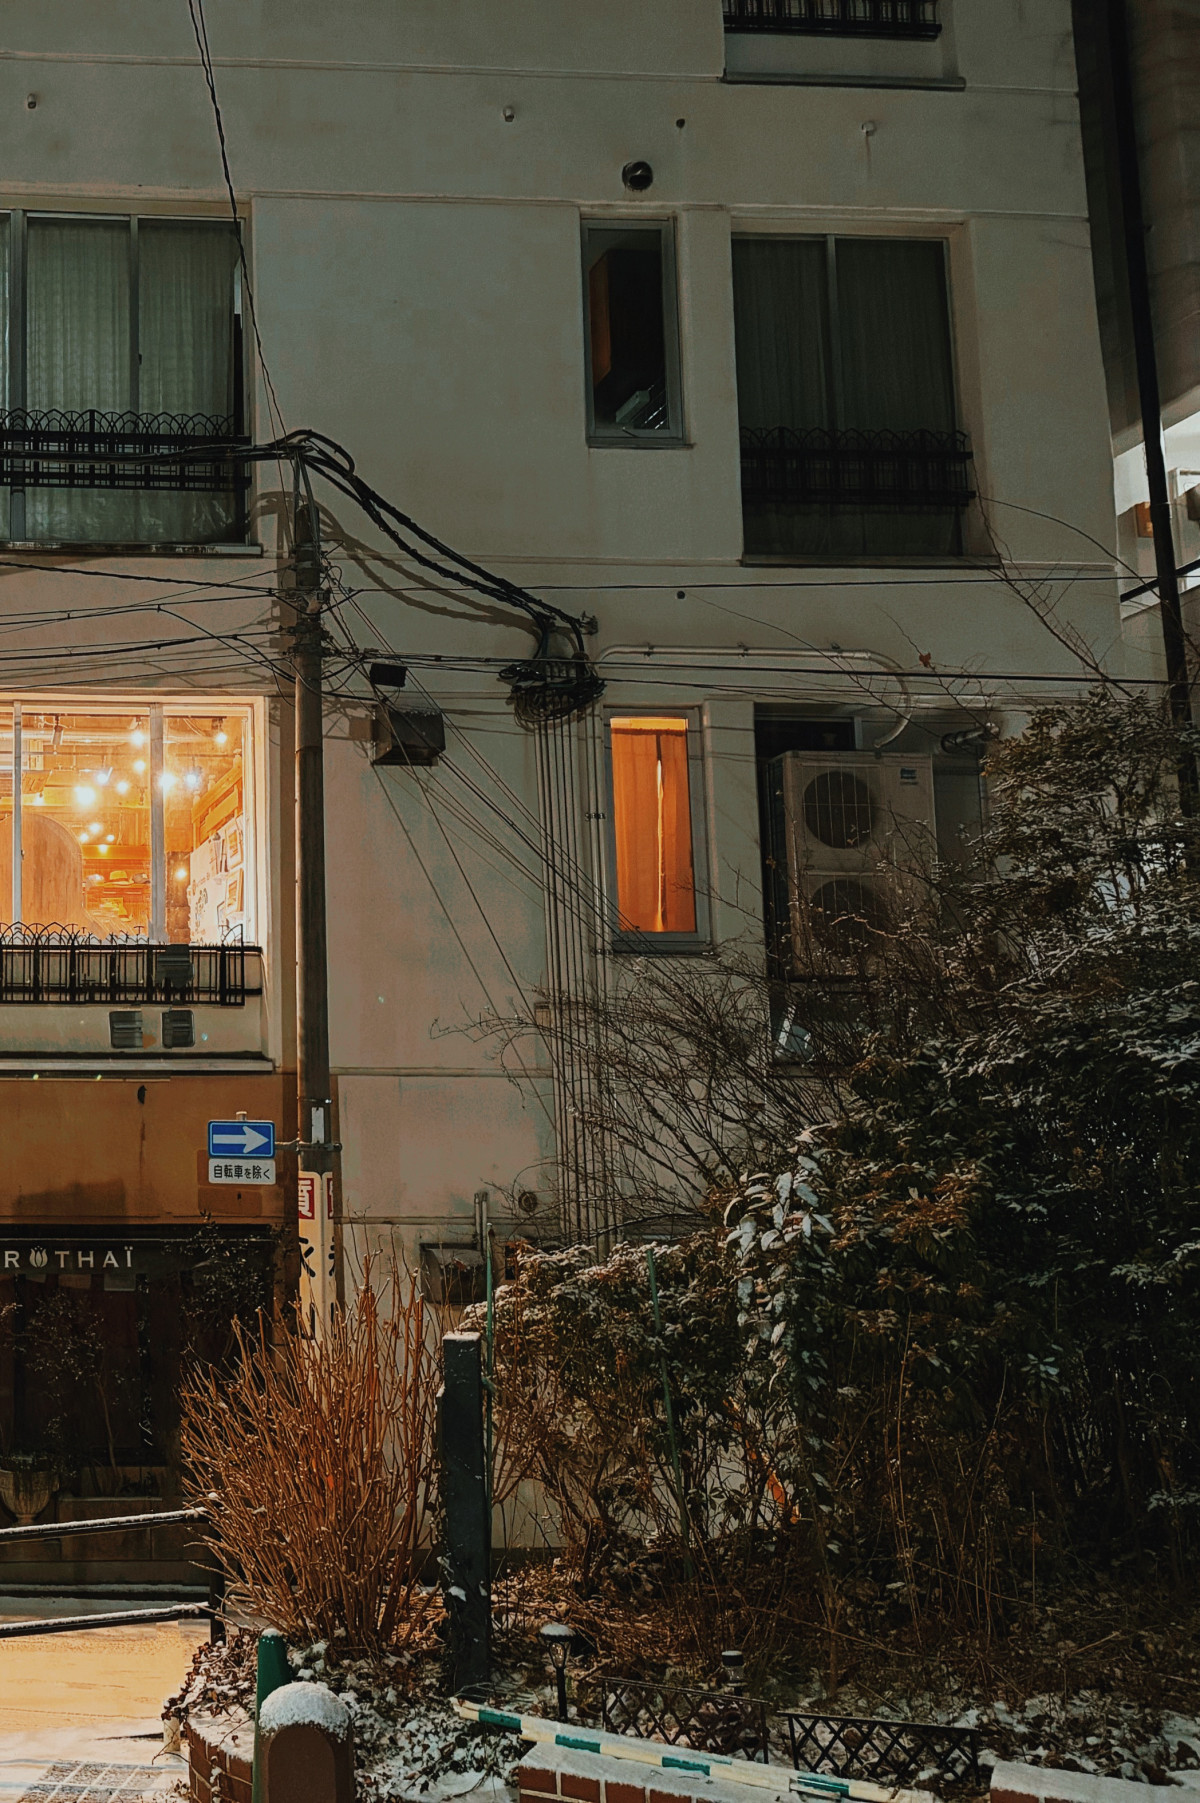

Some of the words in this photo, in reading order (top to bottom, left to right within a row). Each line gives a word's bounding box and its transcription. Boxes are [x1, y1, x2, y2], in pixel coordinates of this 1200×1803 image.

[214, 1164, 271, 1180] 自転車を除く
